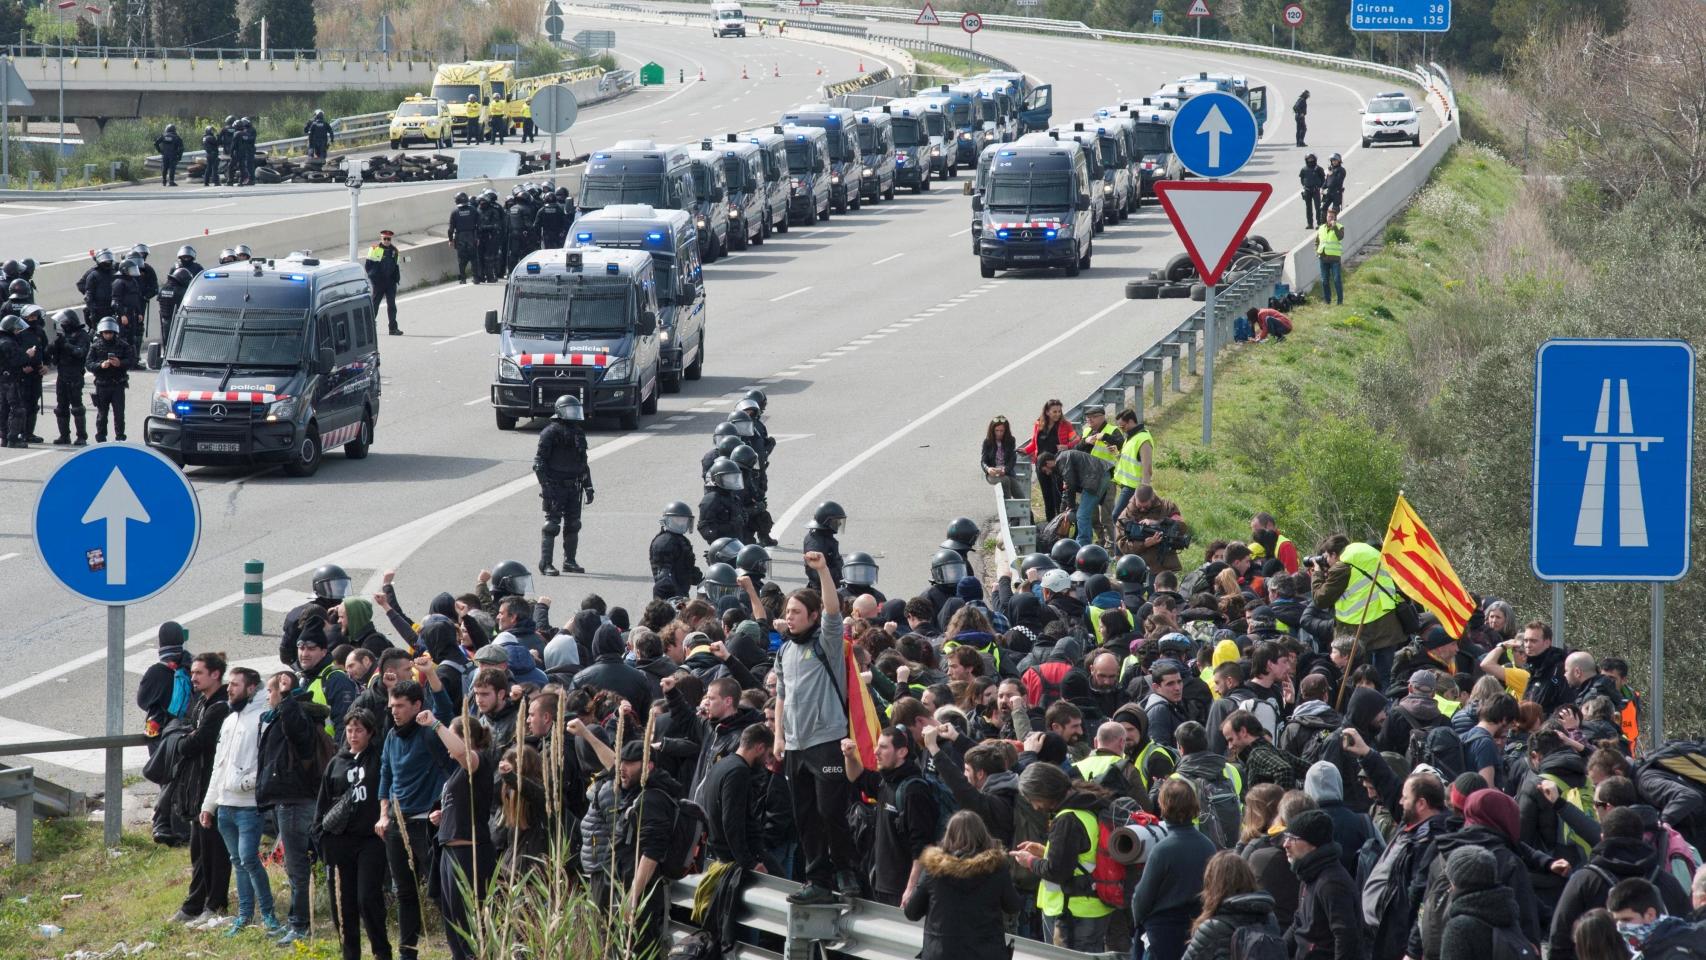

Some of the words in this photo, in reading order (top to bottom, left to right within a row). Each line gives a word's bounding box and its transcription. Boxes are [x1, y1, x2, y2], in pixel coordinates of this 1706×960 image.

[1357, 4, 1394, 13] Girona
[1429, 4, 1444, 13] 38
[1287, 11, 1301, 19] 120
[965, 19, 979, 27] 120
[1356, 15, 1413, 24] Barcelona
[1423, 16, 1444, 25] 135
